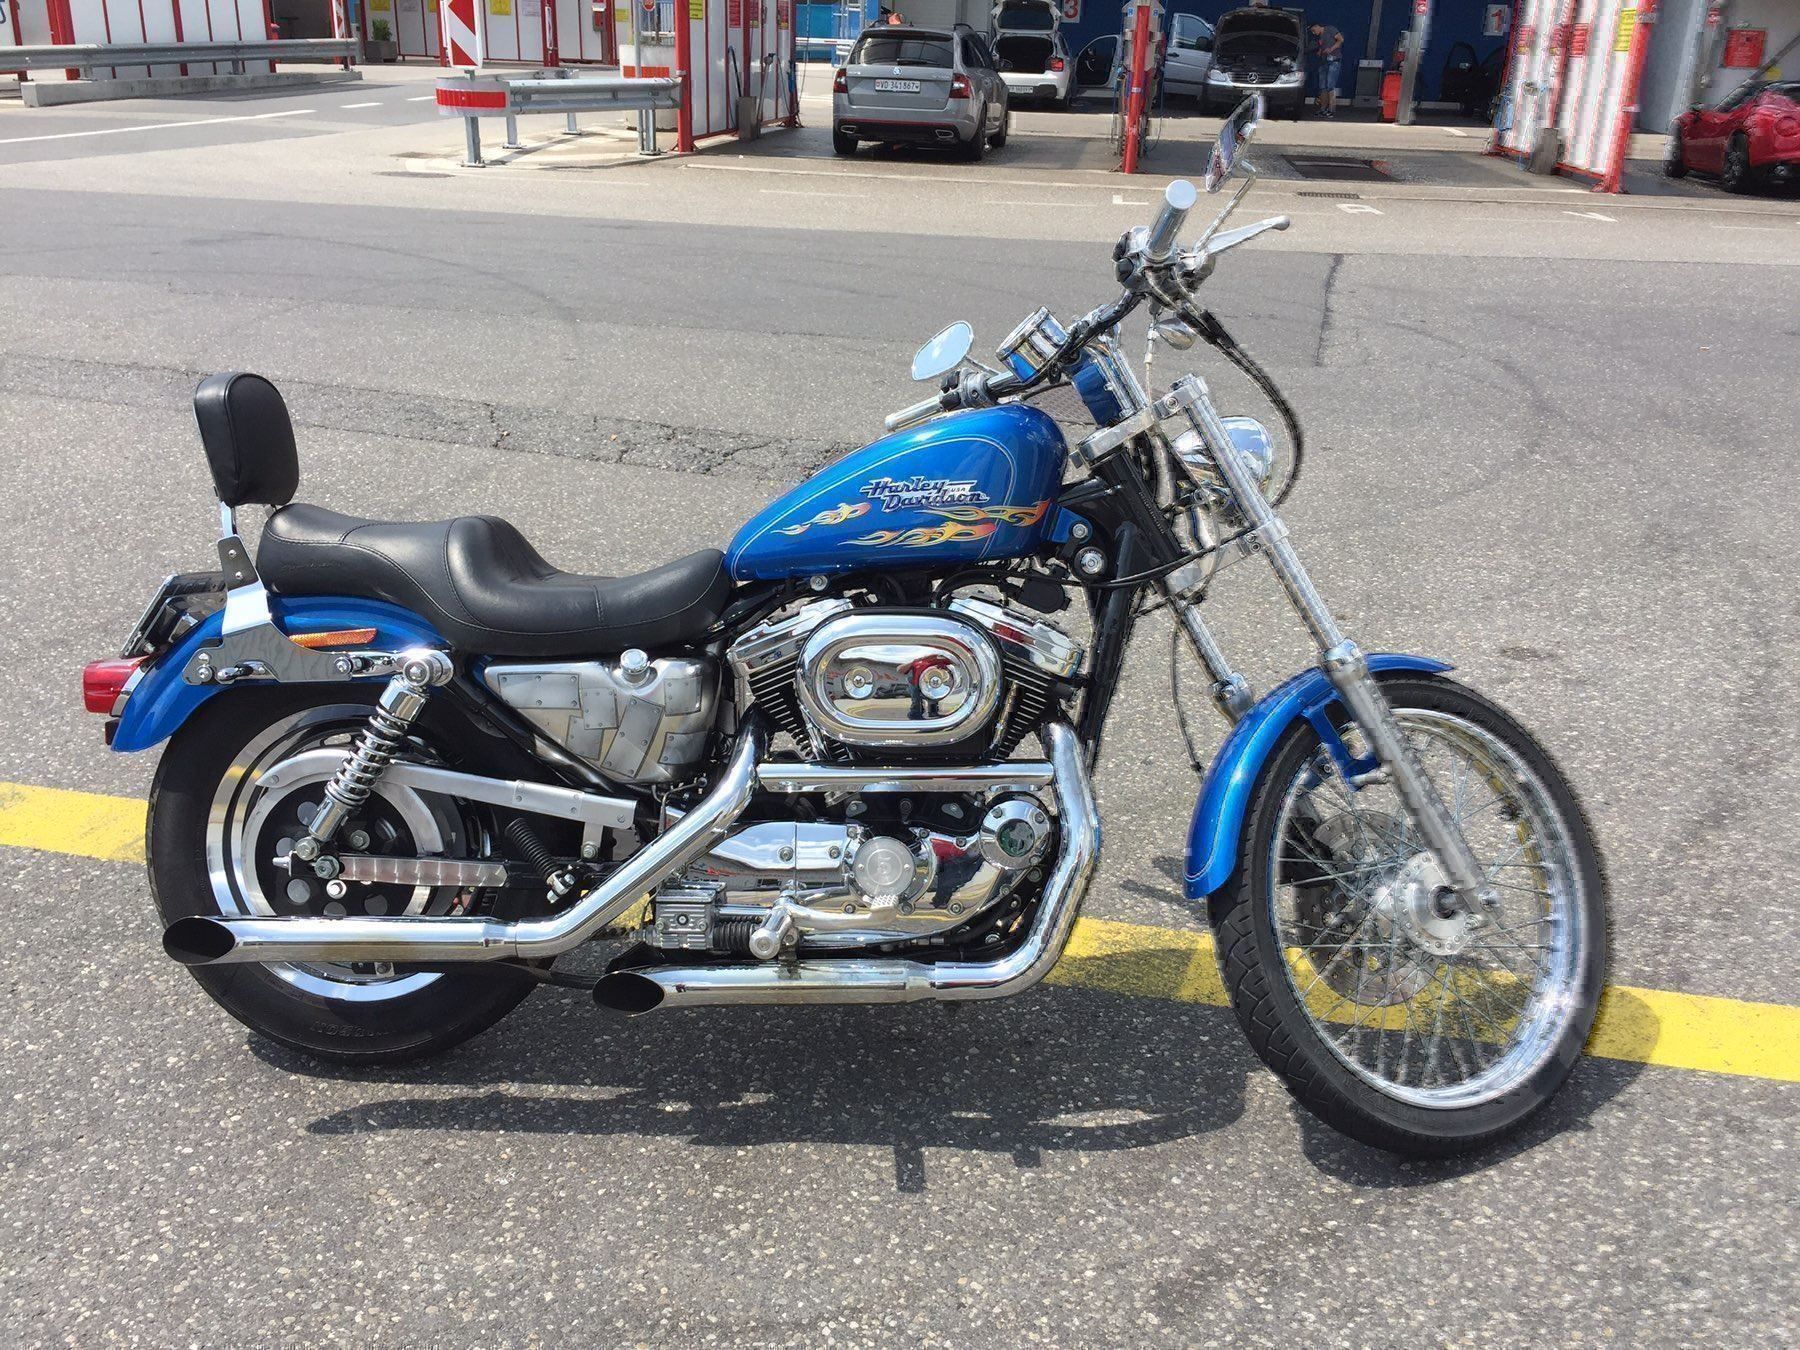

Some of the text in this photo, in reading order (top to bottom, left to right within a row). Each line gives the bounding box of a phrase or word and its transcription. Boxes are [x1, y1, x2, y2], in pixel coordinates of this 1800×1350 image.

[1064, 0, 1078, 18] 3
[1491, 9, 1502, 32] 1
[880, 81, 889, 90] VD
[861, 476, 949, 497] Harley
[882, 489, 989, 511] Davidson
